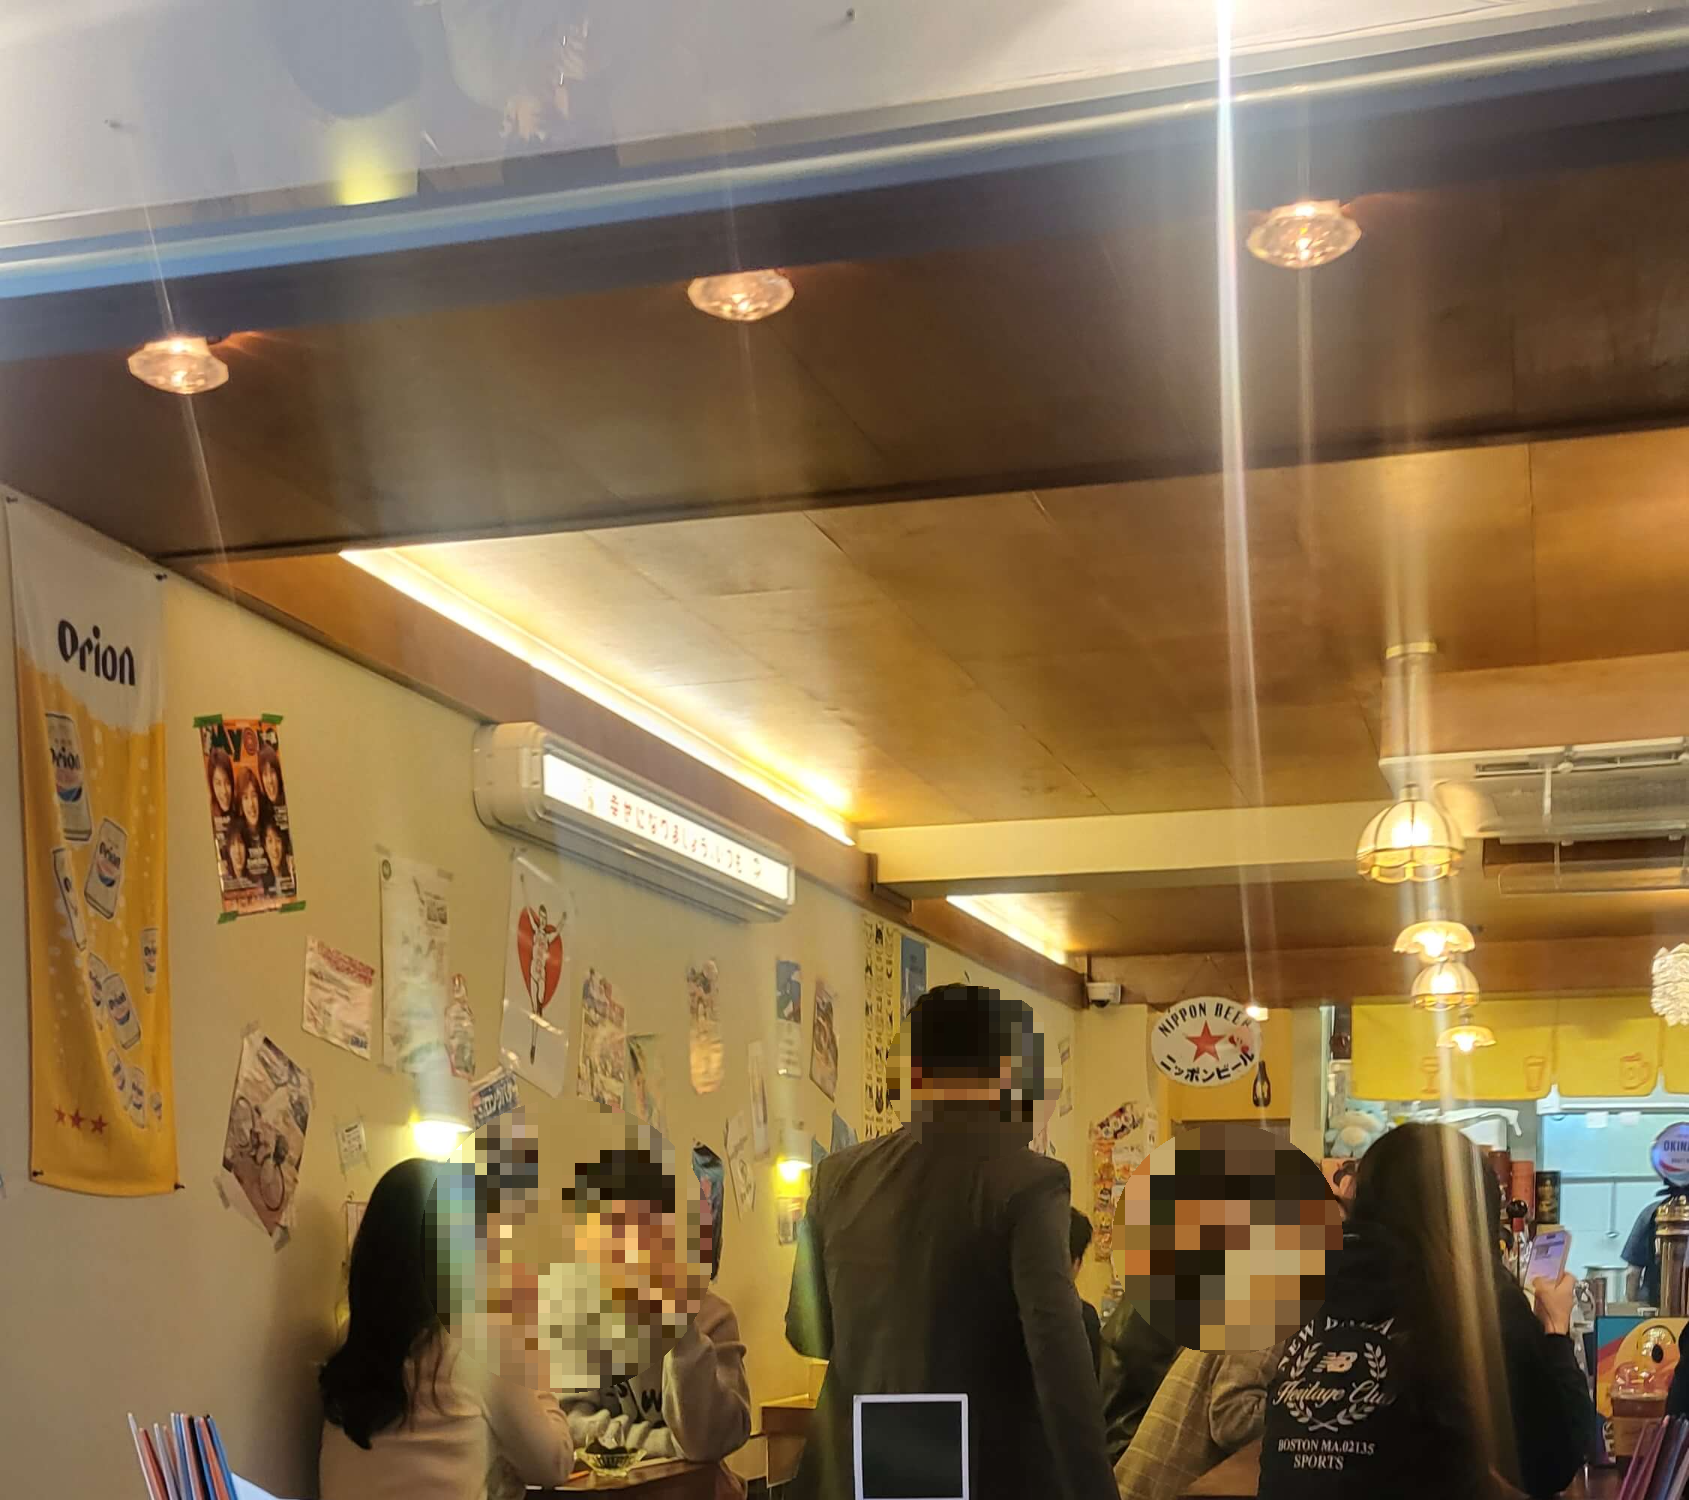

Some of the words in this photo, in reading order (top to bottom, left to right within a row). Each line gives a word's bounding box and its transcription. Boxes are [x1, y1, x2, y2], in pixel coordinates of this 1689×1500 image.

[58, 619, 136, 686] Orion
[1157, 1002, 1207, 1038] NIPPON
[1160, 1053, 1255, 1083] ニッポンビール
[1663, 1140, 1689, 1152] OKIN
[1272, 1378, 1346, 1408] Heritage
[1278, 1438, 1318, 1453] BOSTON
[1293, 1454, 1344, 1471] SPORTS
